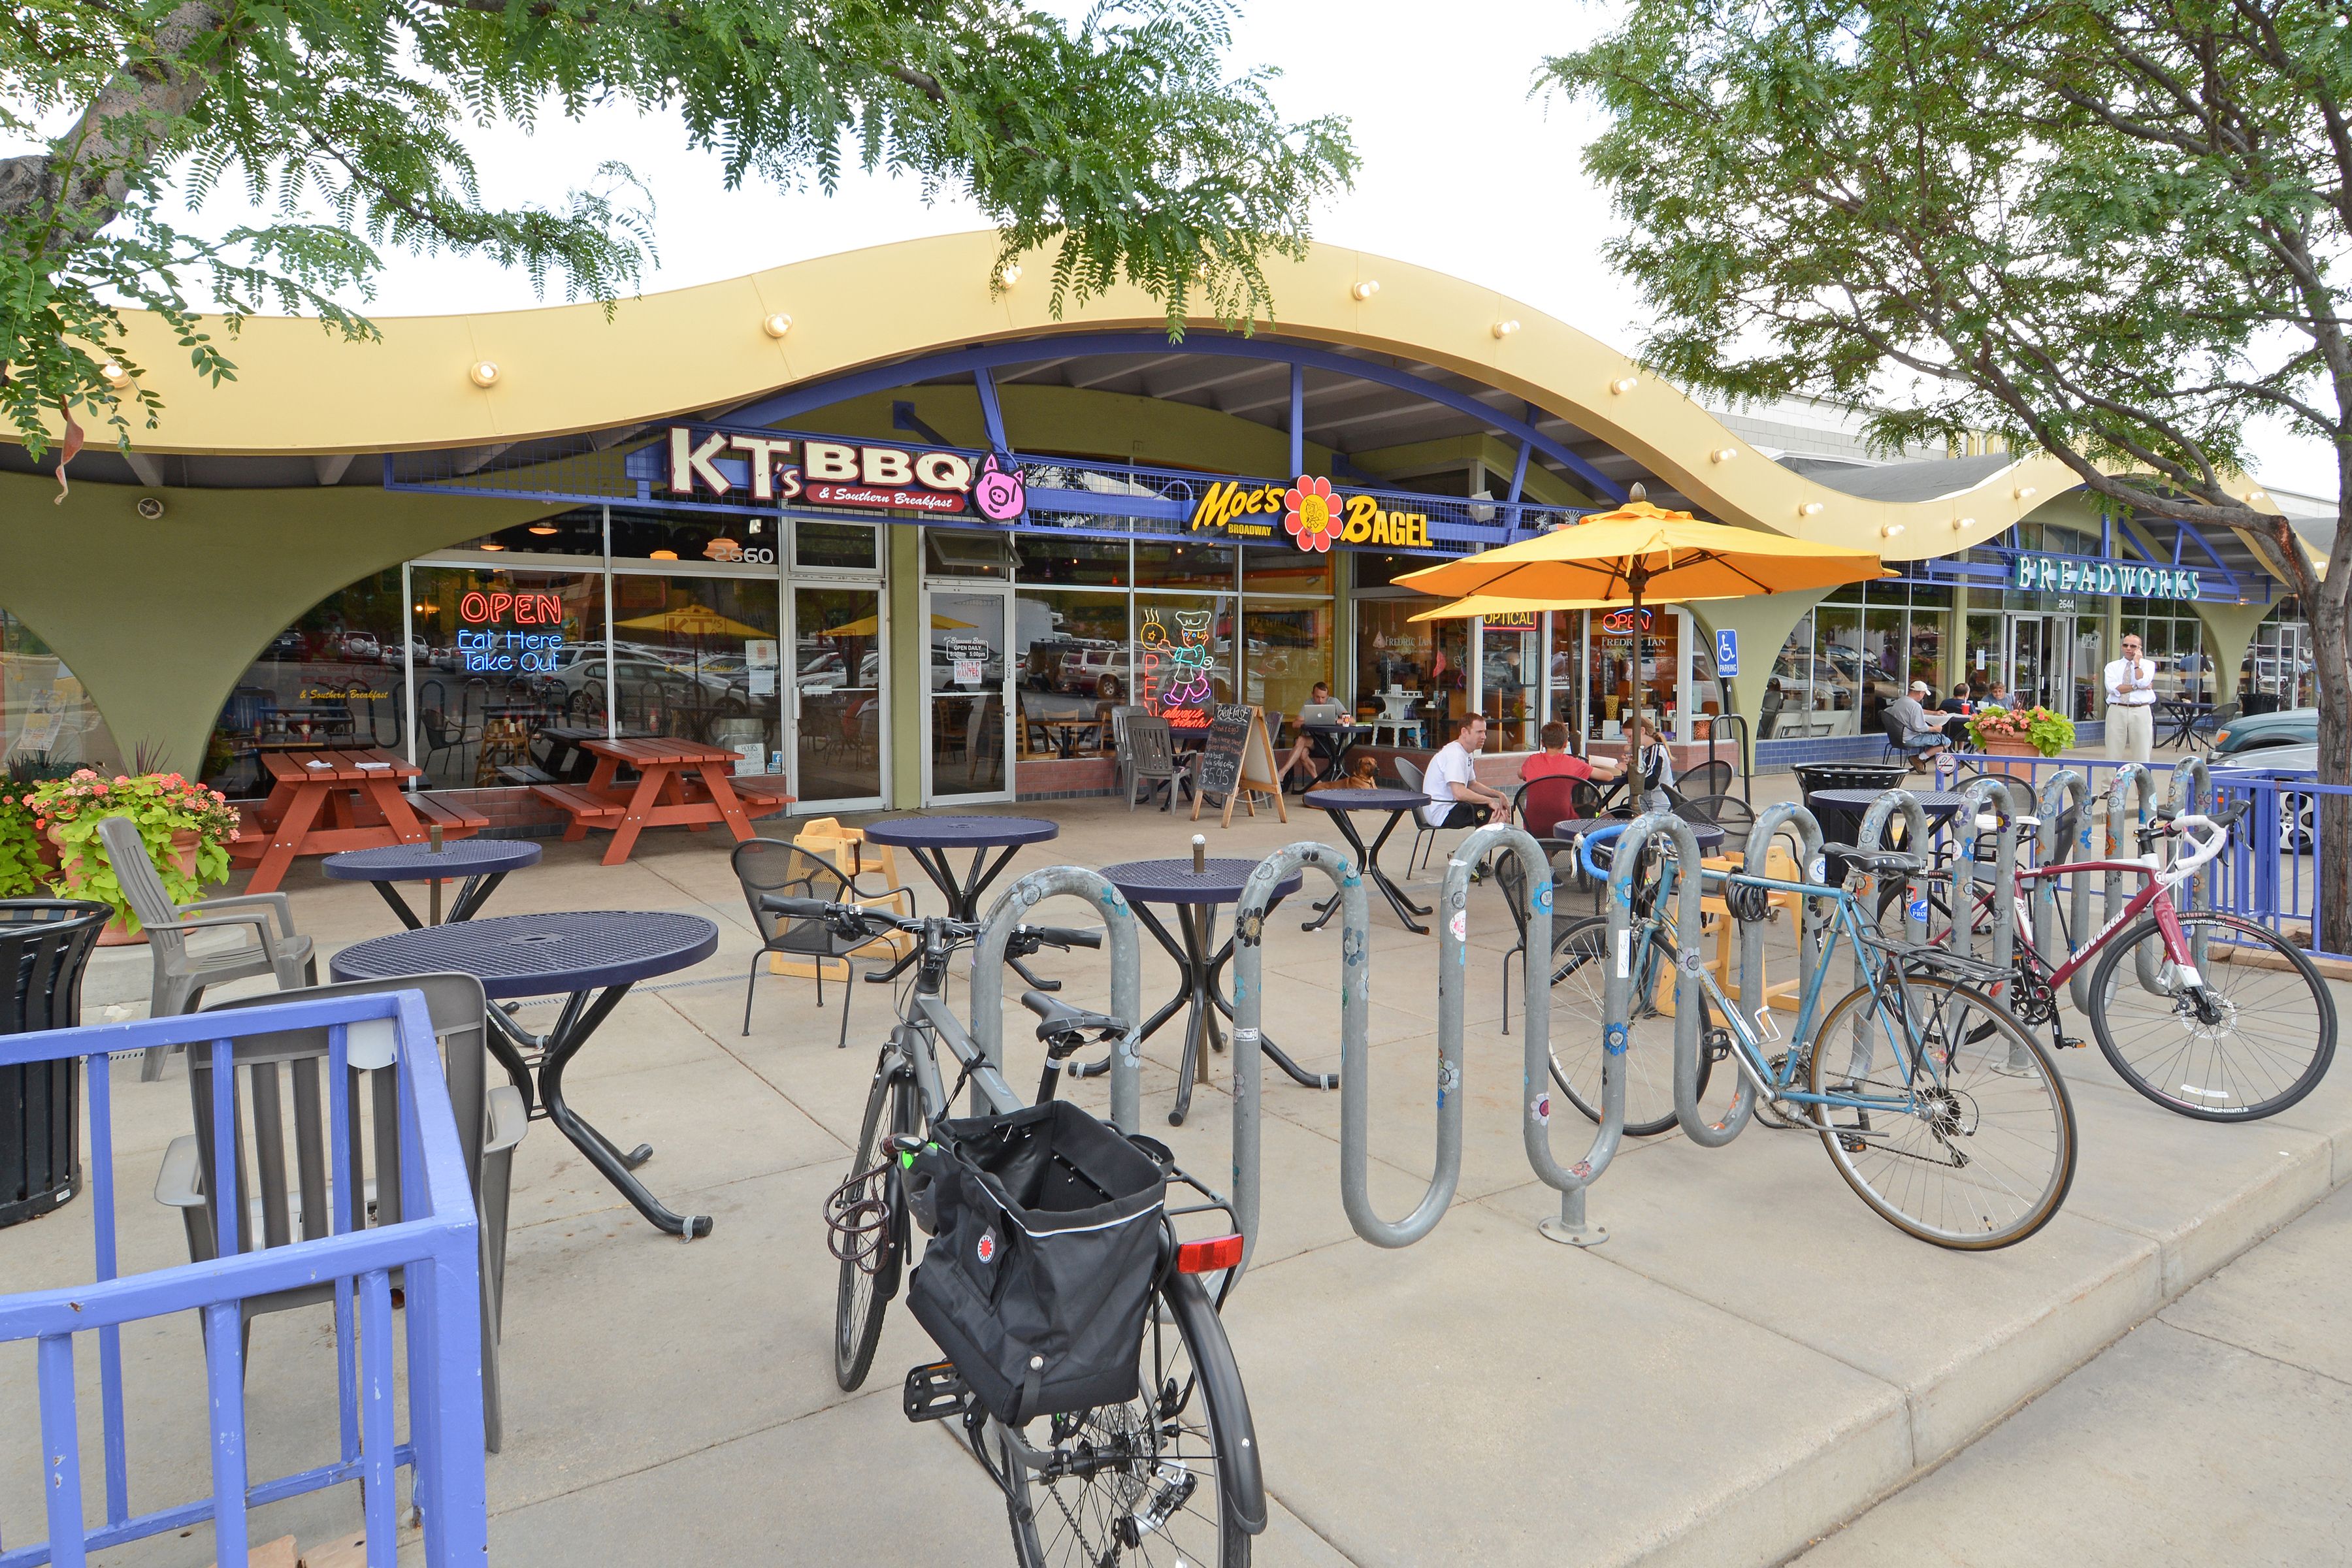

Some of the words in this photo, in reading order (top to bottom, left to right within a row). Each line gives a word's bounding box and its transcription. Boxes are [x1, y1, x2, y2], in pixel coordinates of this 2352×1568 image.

[803, 440, 972, 495] BBQ
[819, 487, 830, 499] &
[835, 488, 890, 503] Southern
[893, 491, 953, 508] Breakfast
[1192, 481, 1285, 532] Moe's
[1340, 495, 1433, 547] BAGEL
[1228, 523, 1272, 536] BROADWAY
[714, 546, 774, 564] 2660
[2017, 556, 2200, 600] BREADWORKS
[461, 591, 563, 624] OPEN
[2059, 599, 2074, 609] 2644
[458, 629, 494, 649] Eat
[506, 630, 563, 649] Here
[460, 651, 513, 670] Take
[520, 652, 559, 671] Out
[310, 689, 346, 699] Southern
[350, 689, 388, 701] Breakfast
[1202, 767, 1229, 785] $5.95
